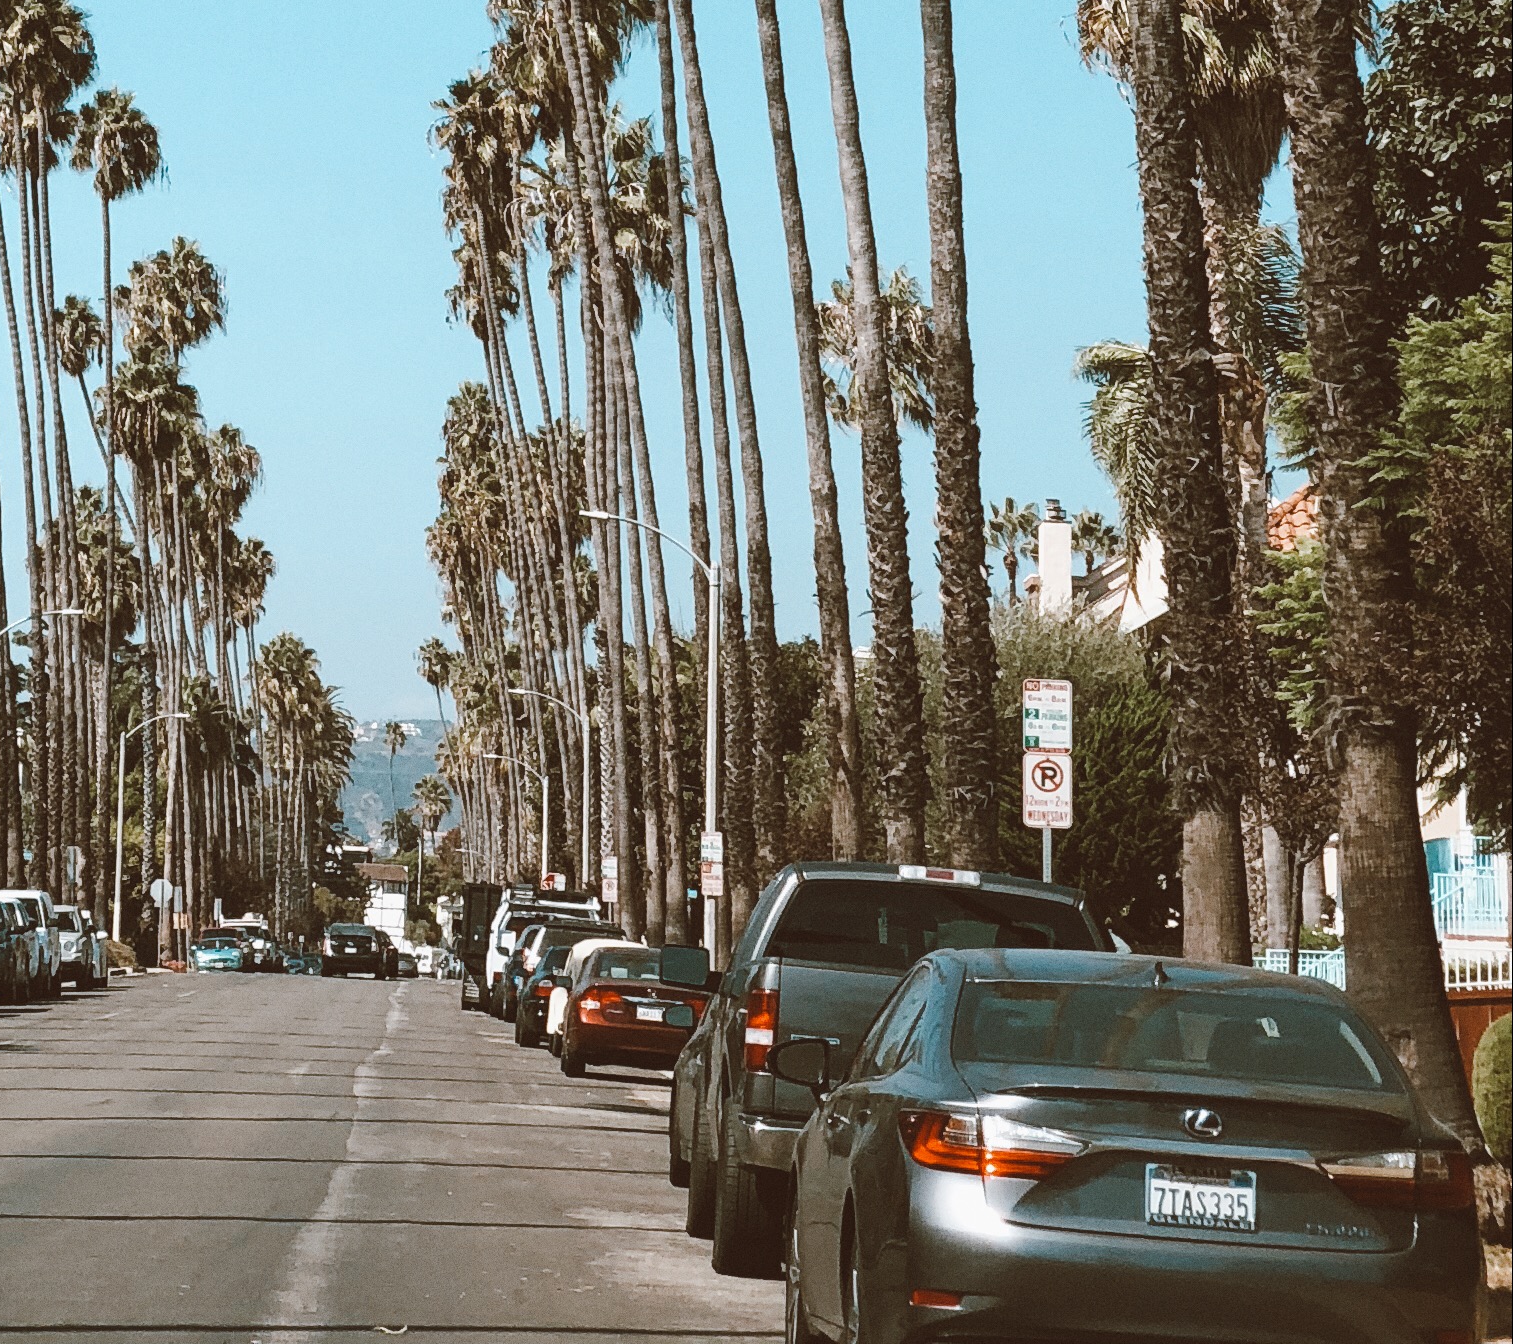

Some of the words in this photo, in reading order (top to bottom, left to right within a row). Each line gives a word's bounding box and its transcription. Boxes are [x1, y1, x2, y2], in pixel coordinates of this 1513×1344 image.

[1026, 681, 1039, 690] NO
[1028, 810, 1068, 822] WEDNESDAY
[542, 880, 553, 890] ST
[1153, 1186, 1249, 1222] 7TAS335
